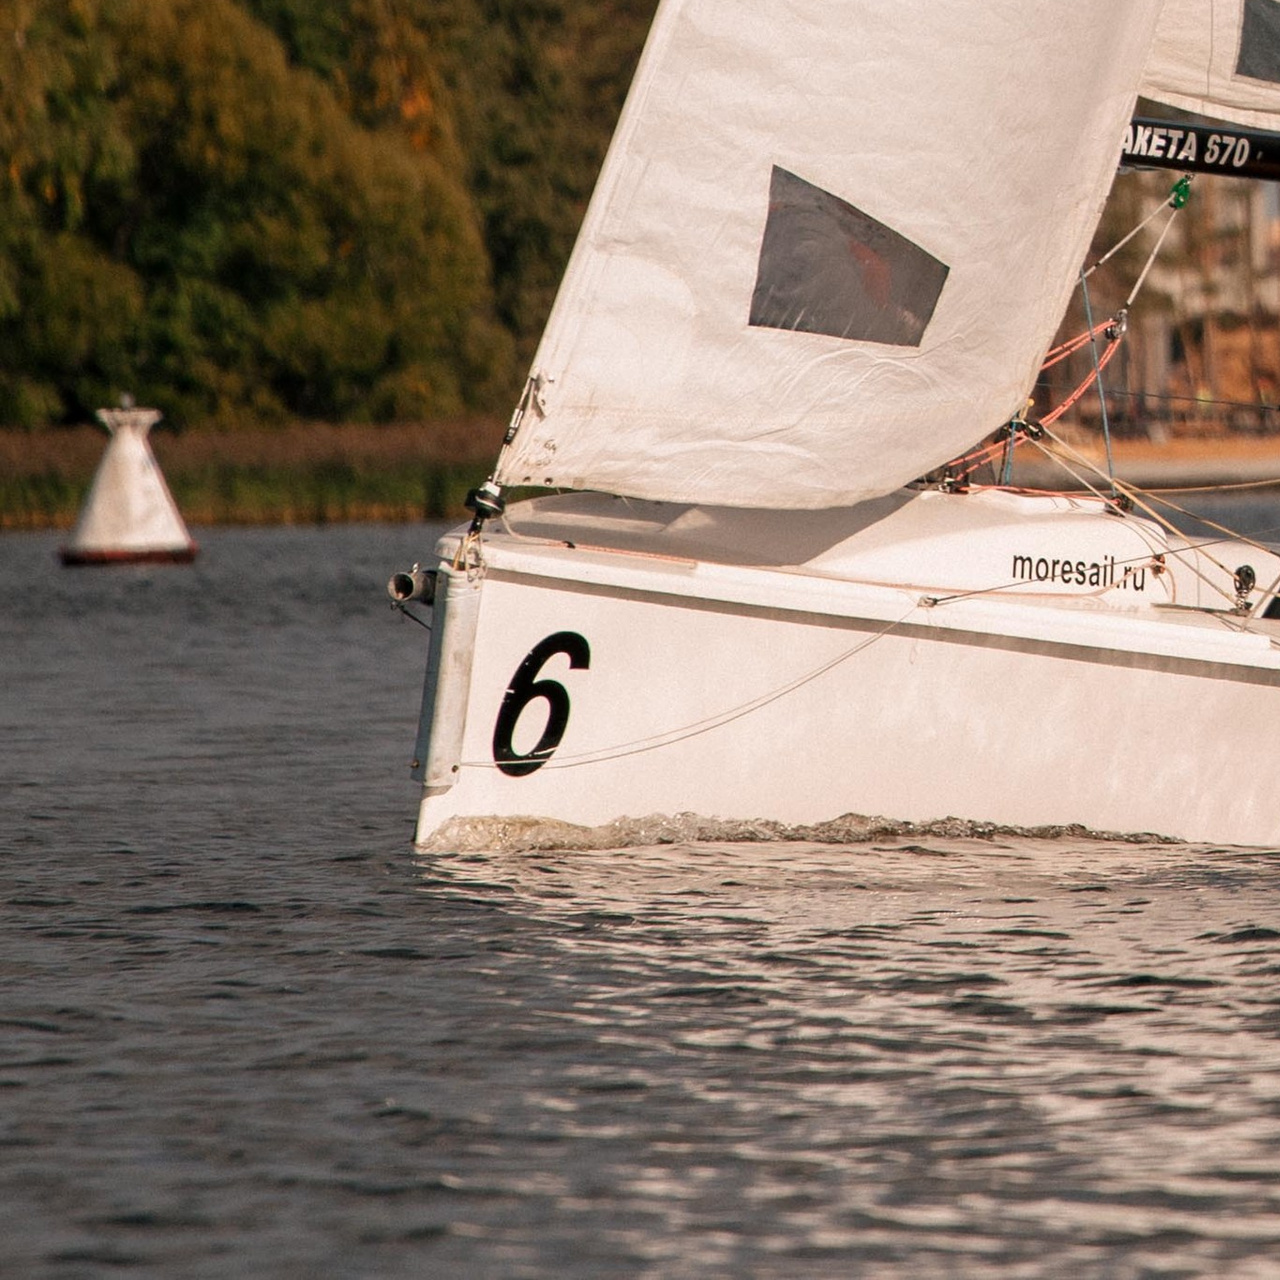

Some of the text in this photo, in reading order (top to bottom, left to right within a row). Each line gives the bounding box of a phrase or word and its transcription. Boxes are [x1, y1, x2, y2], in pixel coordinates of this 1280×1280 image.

[1121, 124, 1197, 162] АКЕТА
[1012, 554, 1146, 592] moresail.ru
[492, 630, 591, 778] 6
